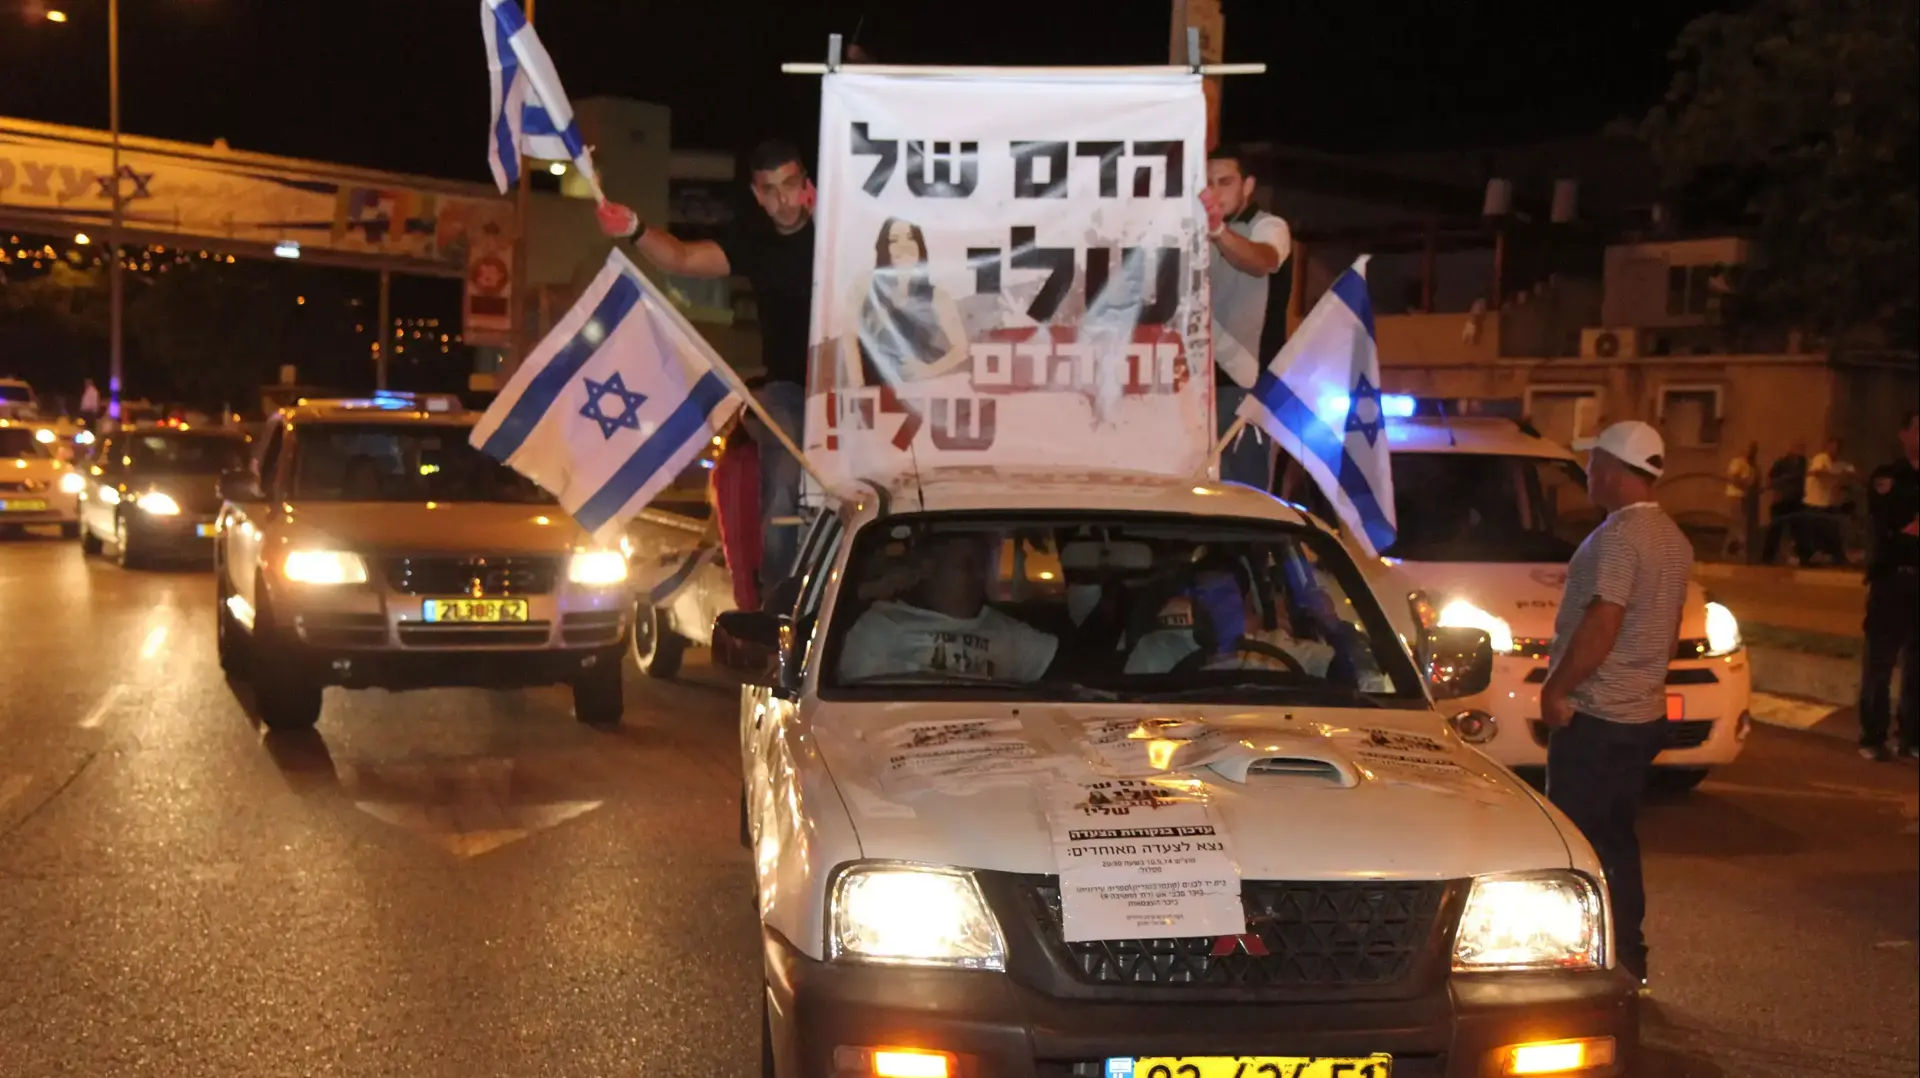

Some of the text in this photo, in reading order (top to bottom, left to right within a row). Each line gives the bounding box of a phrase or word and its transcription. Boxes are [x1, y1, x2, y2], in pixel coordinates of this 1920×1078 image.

[851, 121, 1184, 199] הדם של
[967, 225, 1181, 323] שלי
[970, 342, 1095, 385] הדם
[826, 385, 997, 452] שלי!
[1071, 825, 1214, 840] עדכון בנקודות הצעדה
[1083, 806, 1130, 816] שלי!
[1067, 841, 1224, 857] נצא לצעדה מאוחדים:
